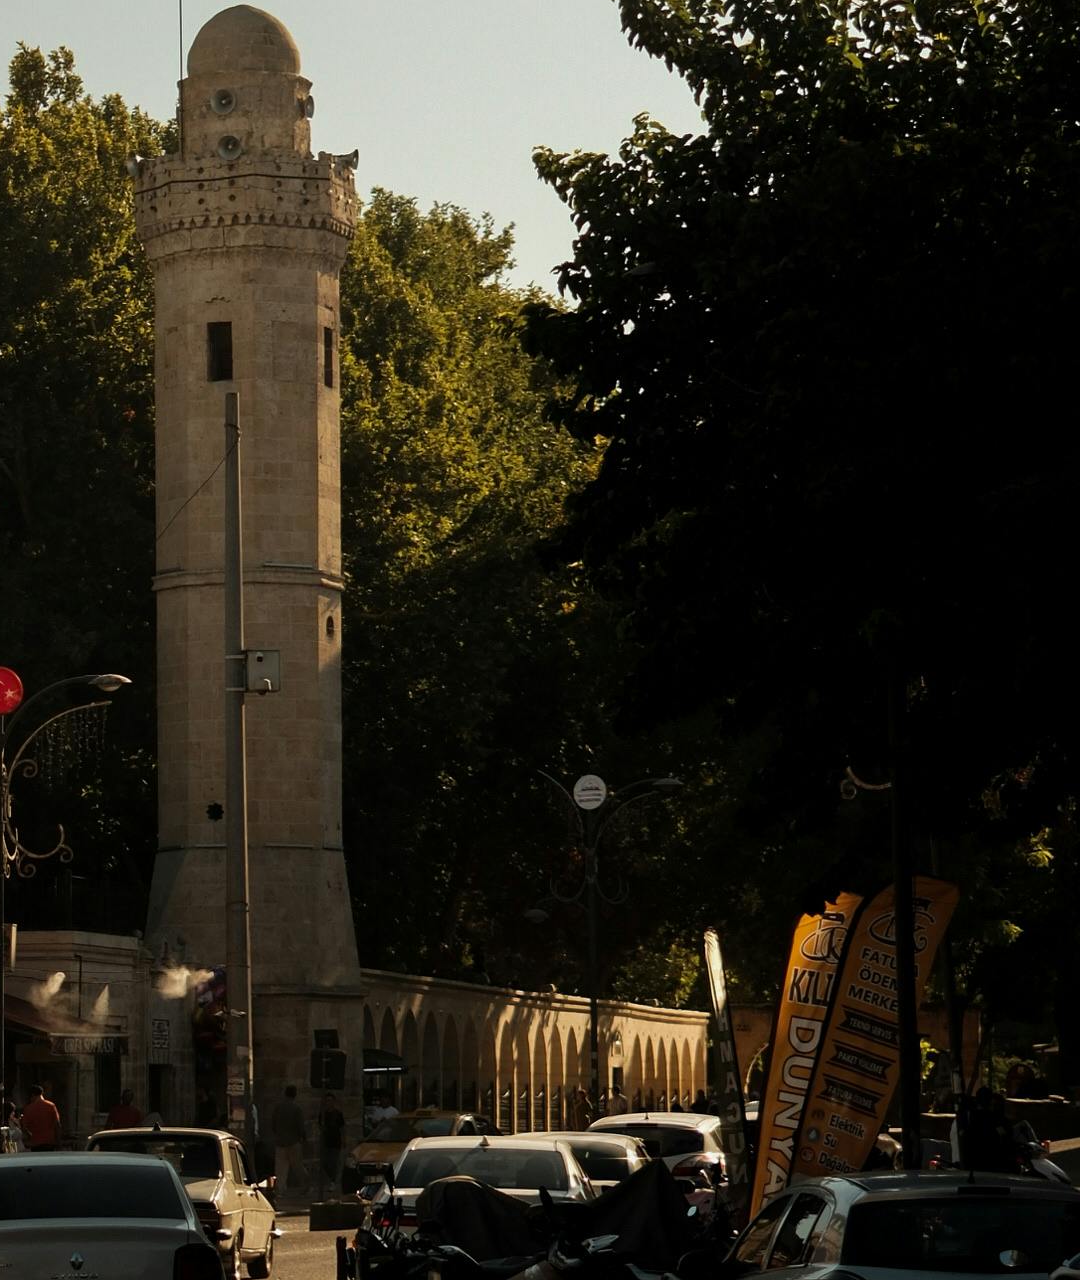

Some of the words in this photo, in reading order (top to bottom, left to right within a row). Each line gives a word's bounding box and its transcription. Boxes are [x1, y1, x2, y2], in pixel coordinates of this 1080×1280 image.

[789, 968, 834, 1007] KILI
[848, 984, 900, 1012] MERKE
[830, 1114, 865, 1138] Elektrik
[823, 1133, 838, 1148] Su
